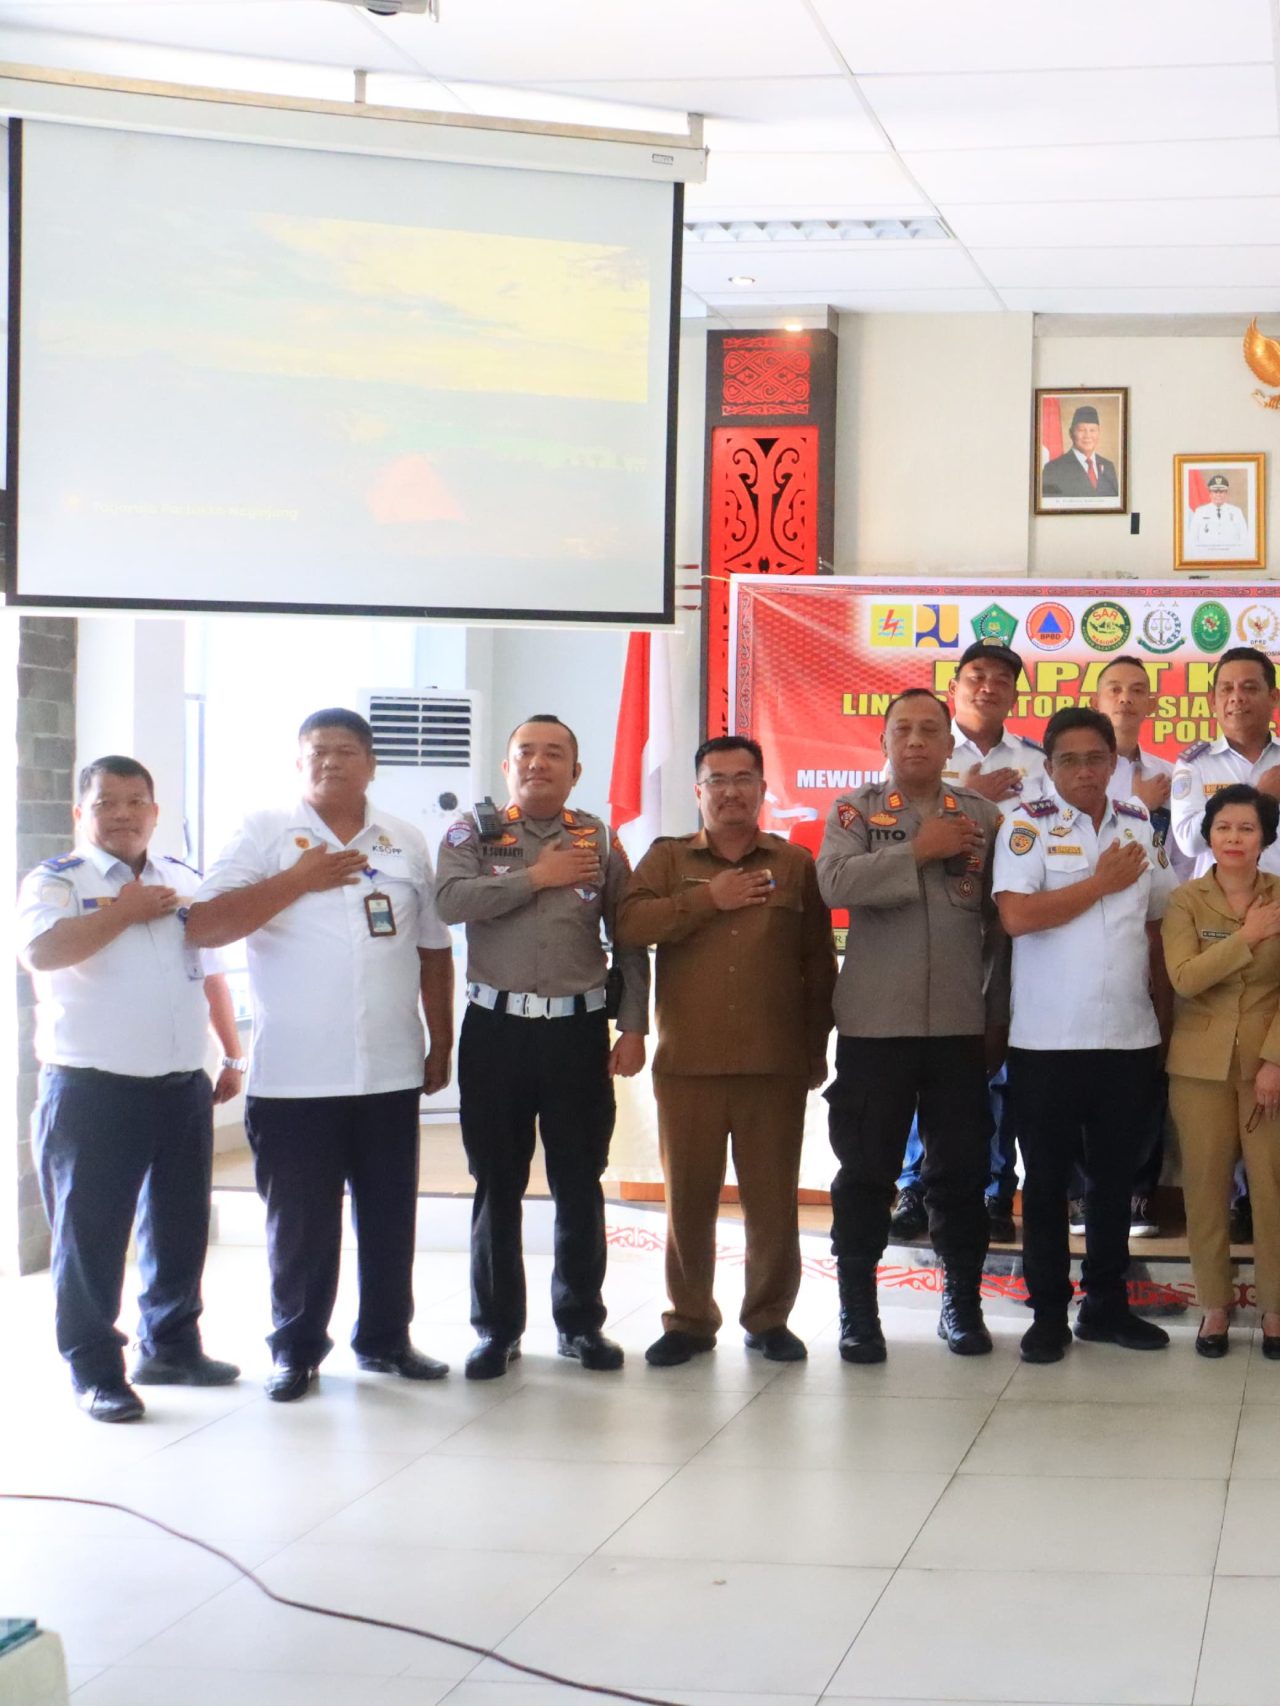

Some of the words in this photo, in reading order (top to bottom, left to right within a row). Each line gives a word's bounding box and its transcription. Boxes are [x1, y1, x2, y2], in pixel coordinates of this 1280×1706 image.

[1092, 608, 1118, 621] SAR
[1040, 633, 1062, 641] BPBD
[867, 828, 906, 841] TITO
